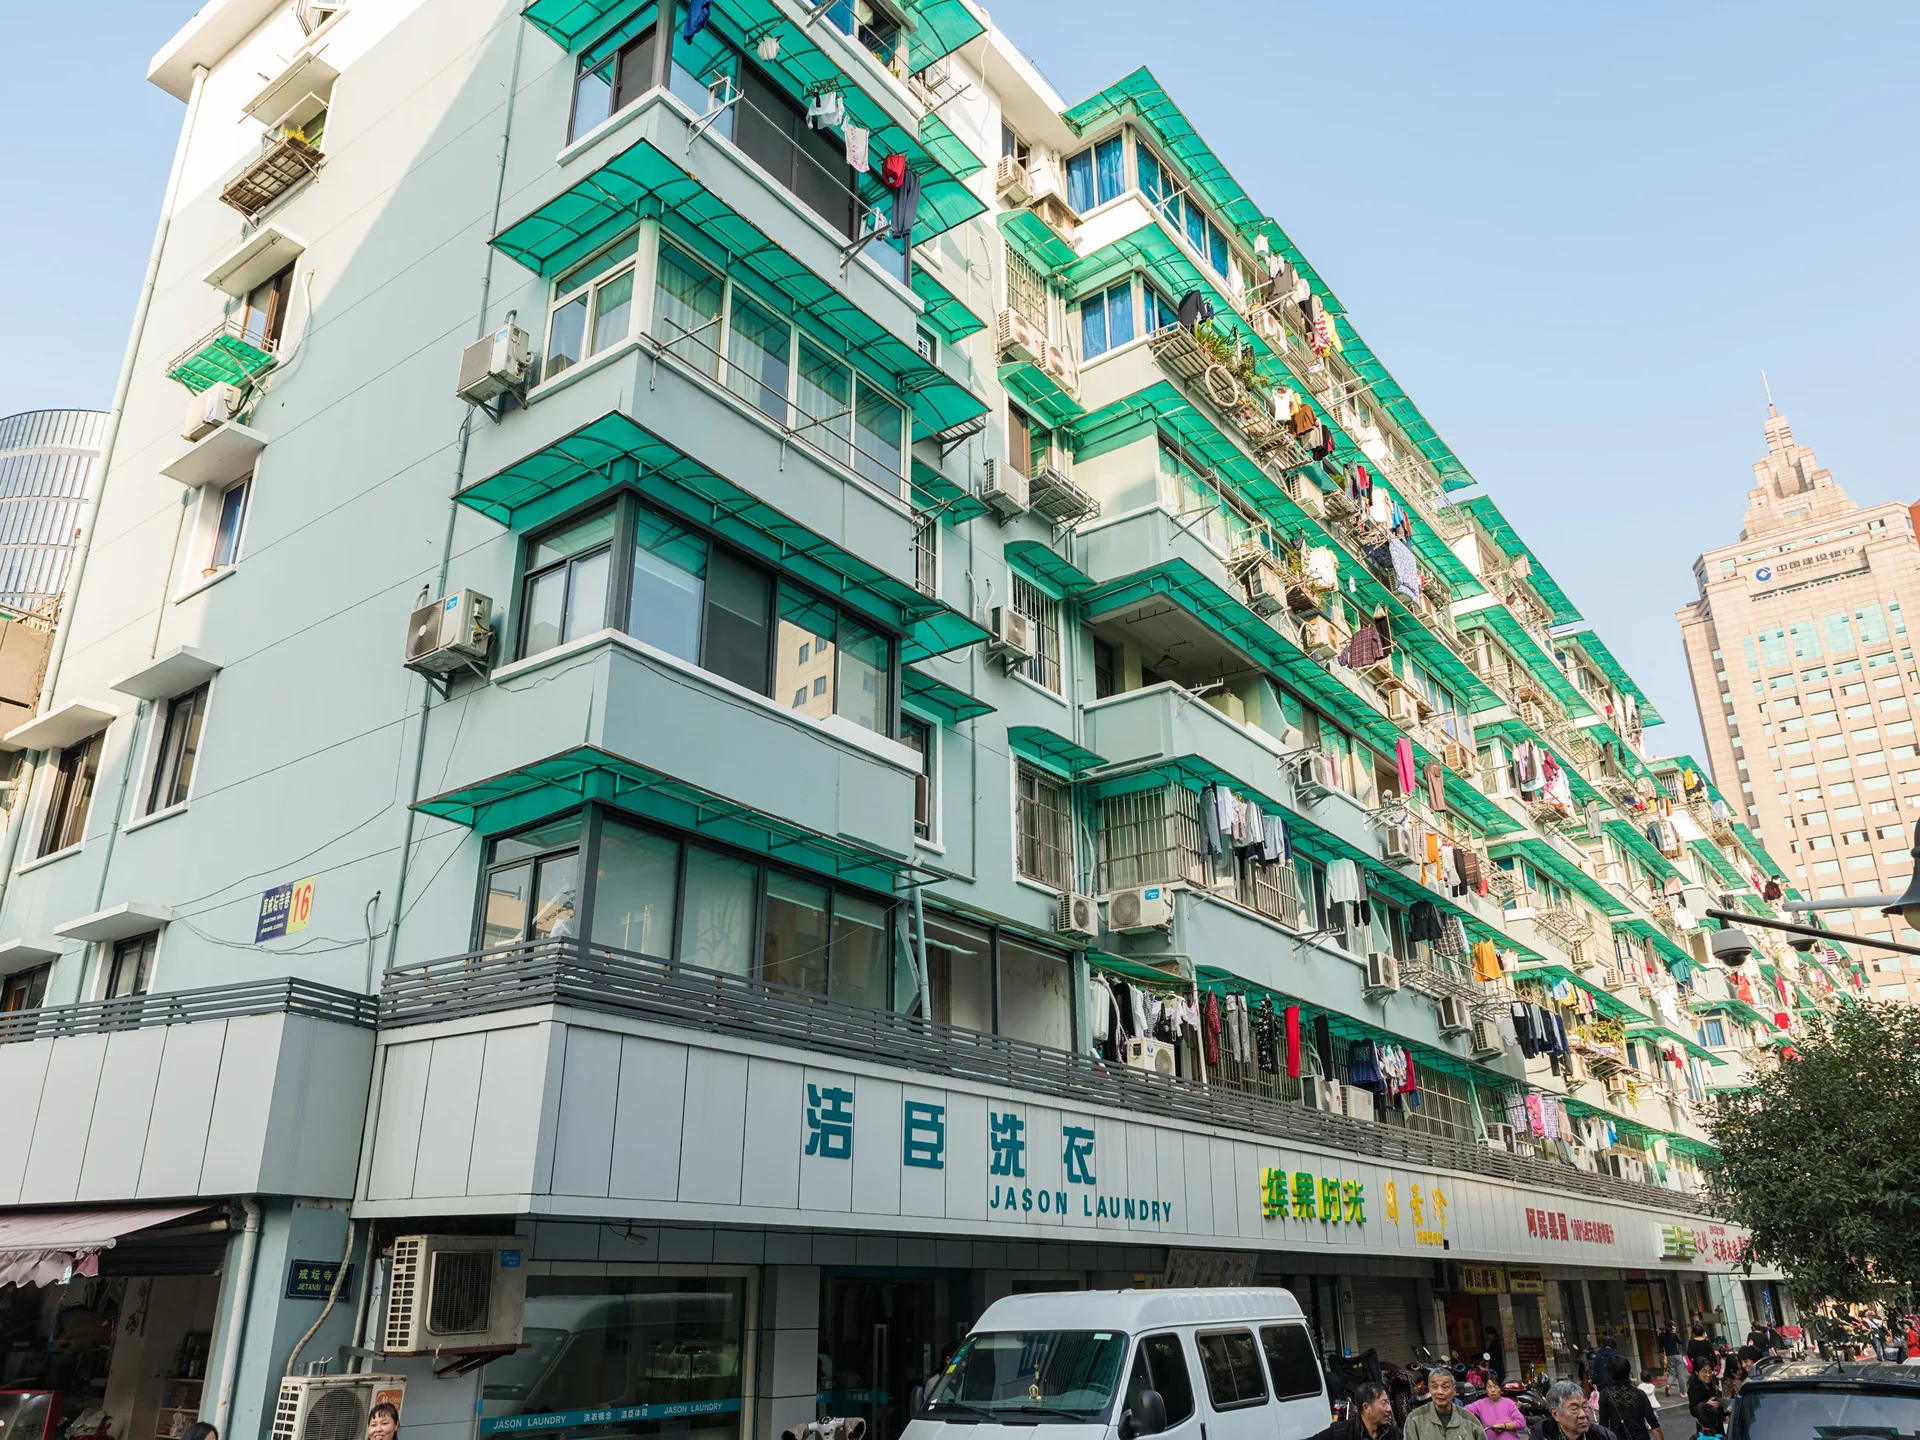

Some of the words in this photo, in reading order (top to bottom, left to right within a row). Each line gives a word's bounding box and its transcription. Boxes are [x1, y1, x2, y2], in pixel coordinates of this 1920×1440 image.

[1776, 546, 1855, 572] 中国建设银行
[293, 884, 311, 923] 16
[804, 1082, 1097, 1185] 洁臣洗衣
[1261, 1167, 1367, 1223] 缤果时光
[990, 1185, 1068, 1214] JASON
[1083, 1194, 1173, 1222] LAUNDRY
[298, 1268, 340, 1282] 戒坛寺
[297, 1283, 321, 1291] JIETANSI
[377, 1392, 401, 1405] Midea
[663, 1405, 687, 1415] JASON
[690, 1402, 723, 1413] LAUNDRY
[493, 1418, 522, 1430] JASON
[527, 1415, 567, 1427] LAUNDRY
[583, 1411, 612, 1422] 洗衣概念
